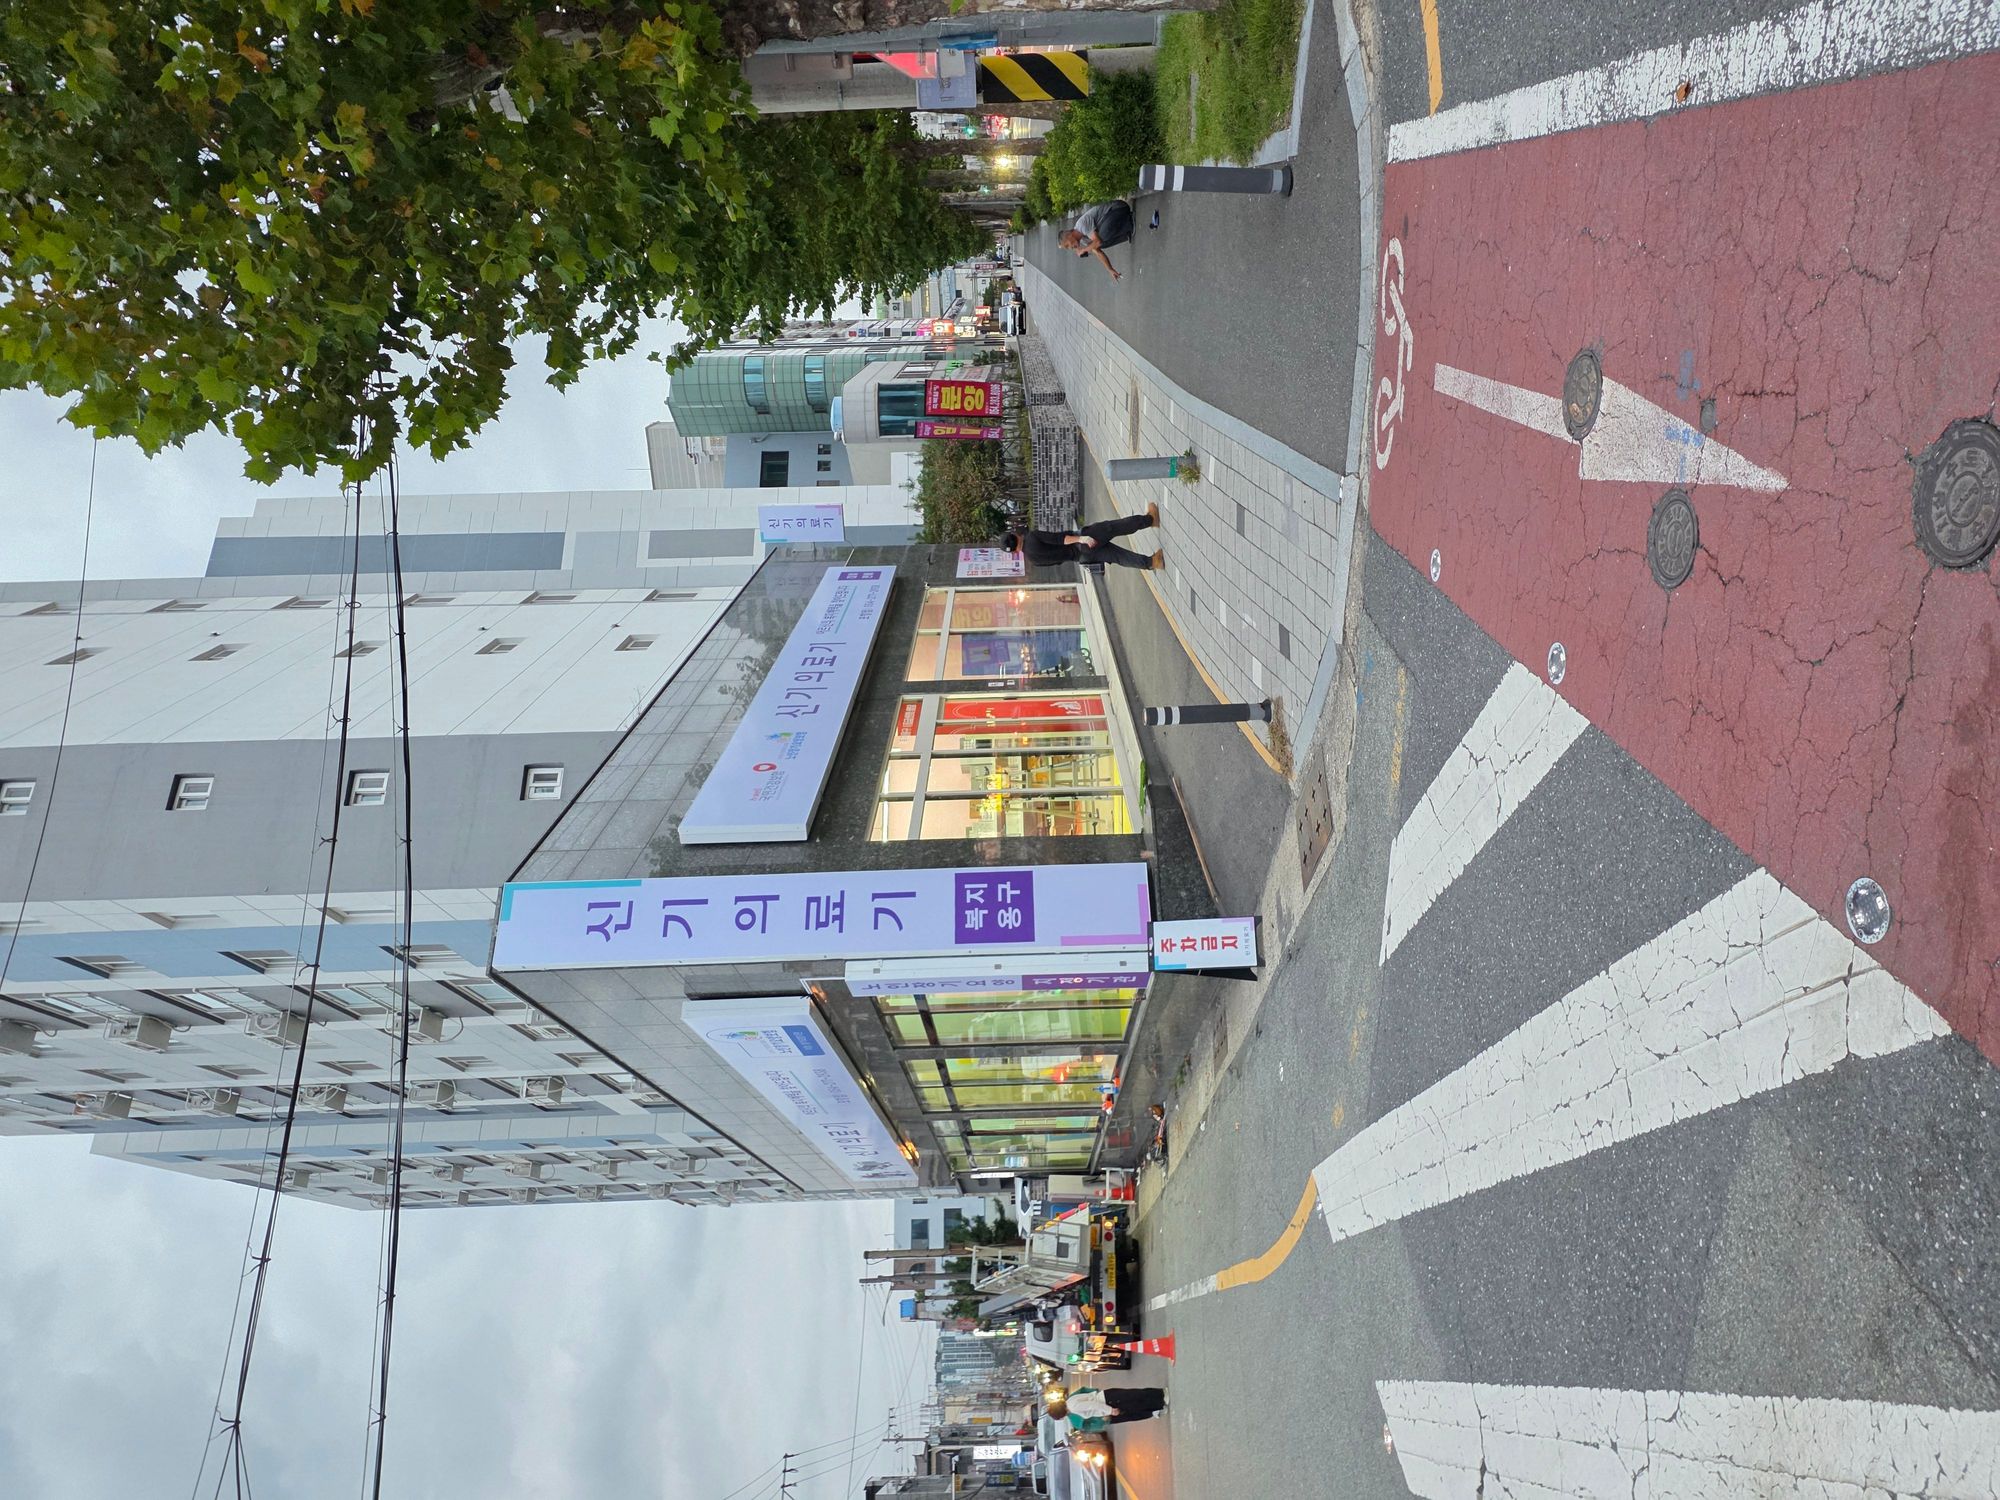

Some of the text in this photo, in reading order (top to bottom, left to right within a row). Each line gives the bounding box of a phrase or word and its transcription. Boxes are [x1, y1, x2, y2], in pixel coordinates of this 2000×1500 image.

[941, 385, 985, 411] 분양
[768, 517, 835, 529] 신기의료기
[775, 642, 847, 718] 신기의료기
[586, 891, 916, 942] 신기의료기
[964, 883, 988, 930] 복지
[997, 881, 1022, 930] 용구
[1161, 935, 1238, 953] 주차금지
[862, 979, 1015, 990] 노인장기요양
[1032, 976, 1137, 985] 지정기관
[818, 1122, 879, 1157] 신기의료기
